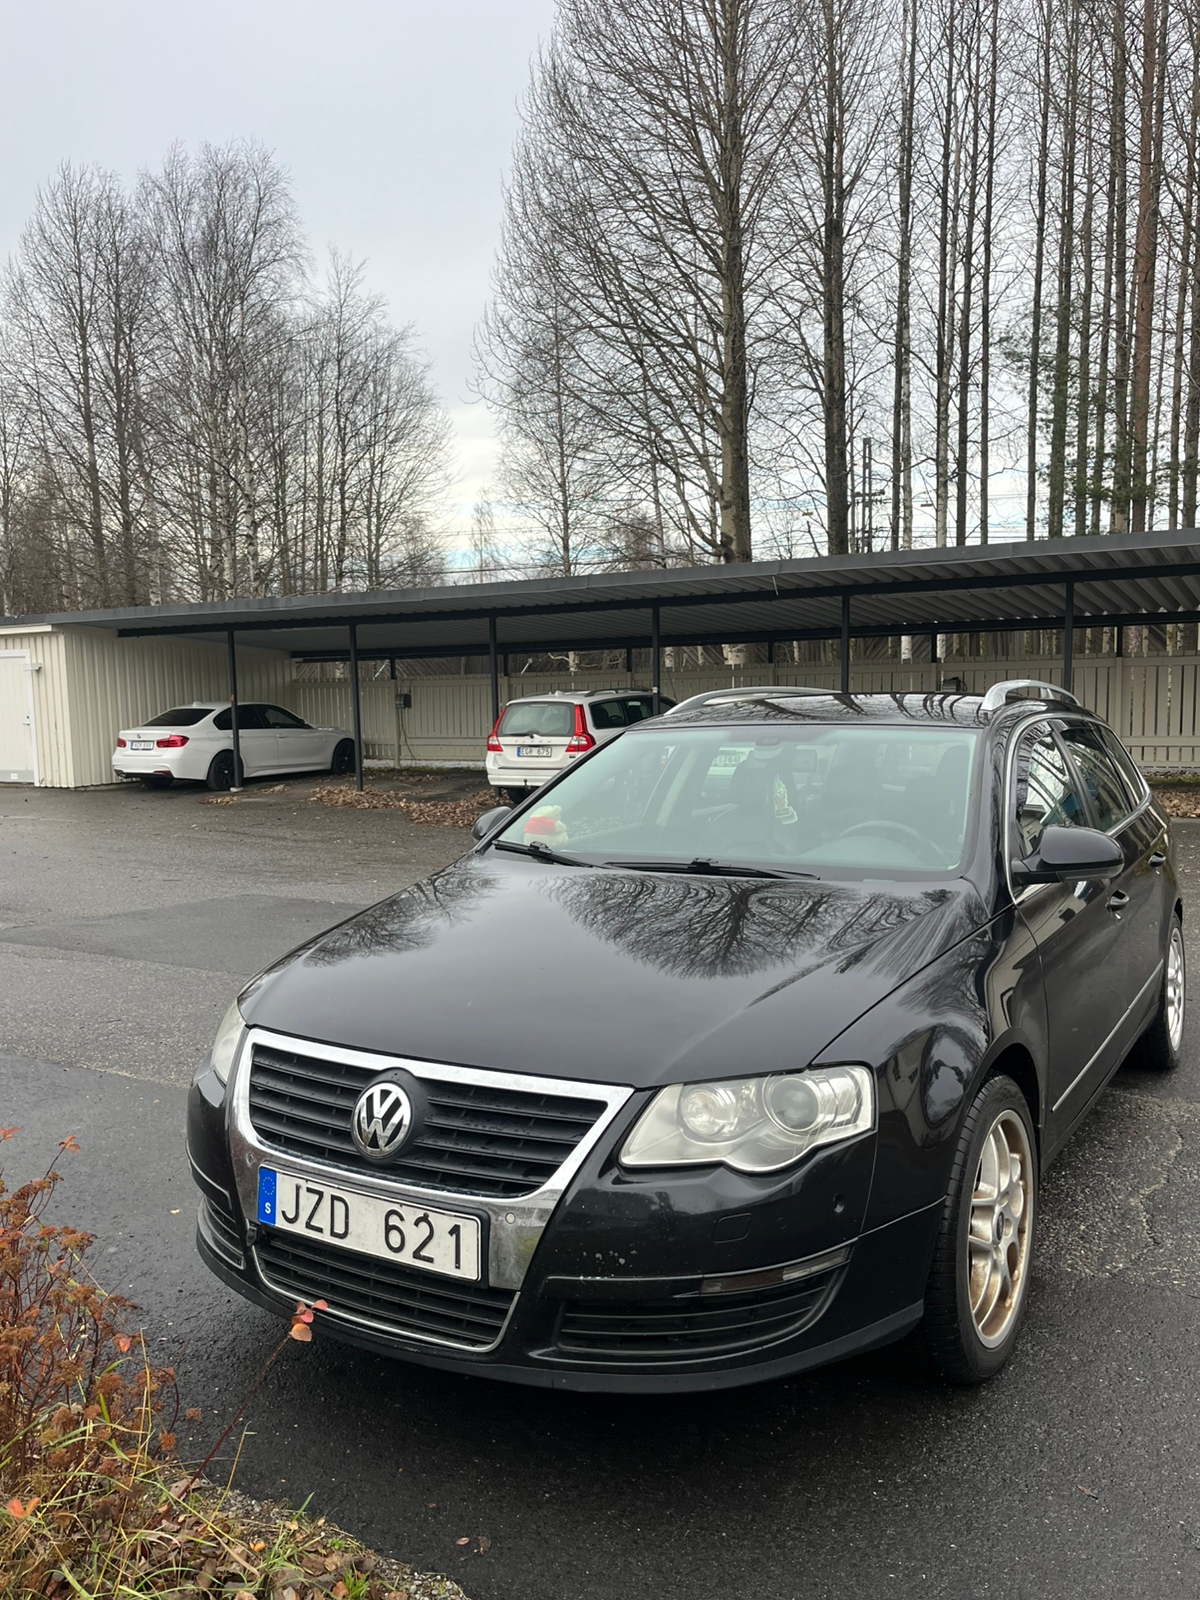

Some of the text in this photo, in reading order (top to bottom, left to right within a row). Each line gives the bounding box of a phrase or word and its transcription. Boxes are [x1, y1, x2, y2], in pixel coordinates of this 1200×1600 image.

[537, 747, 550, 756] 675
[357, 1086, 407, 1153] VW
[264, 1201, 272, 1215] S
[281, 1183, 462, 1270] JZD 621
